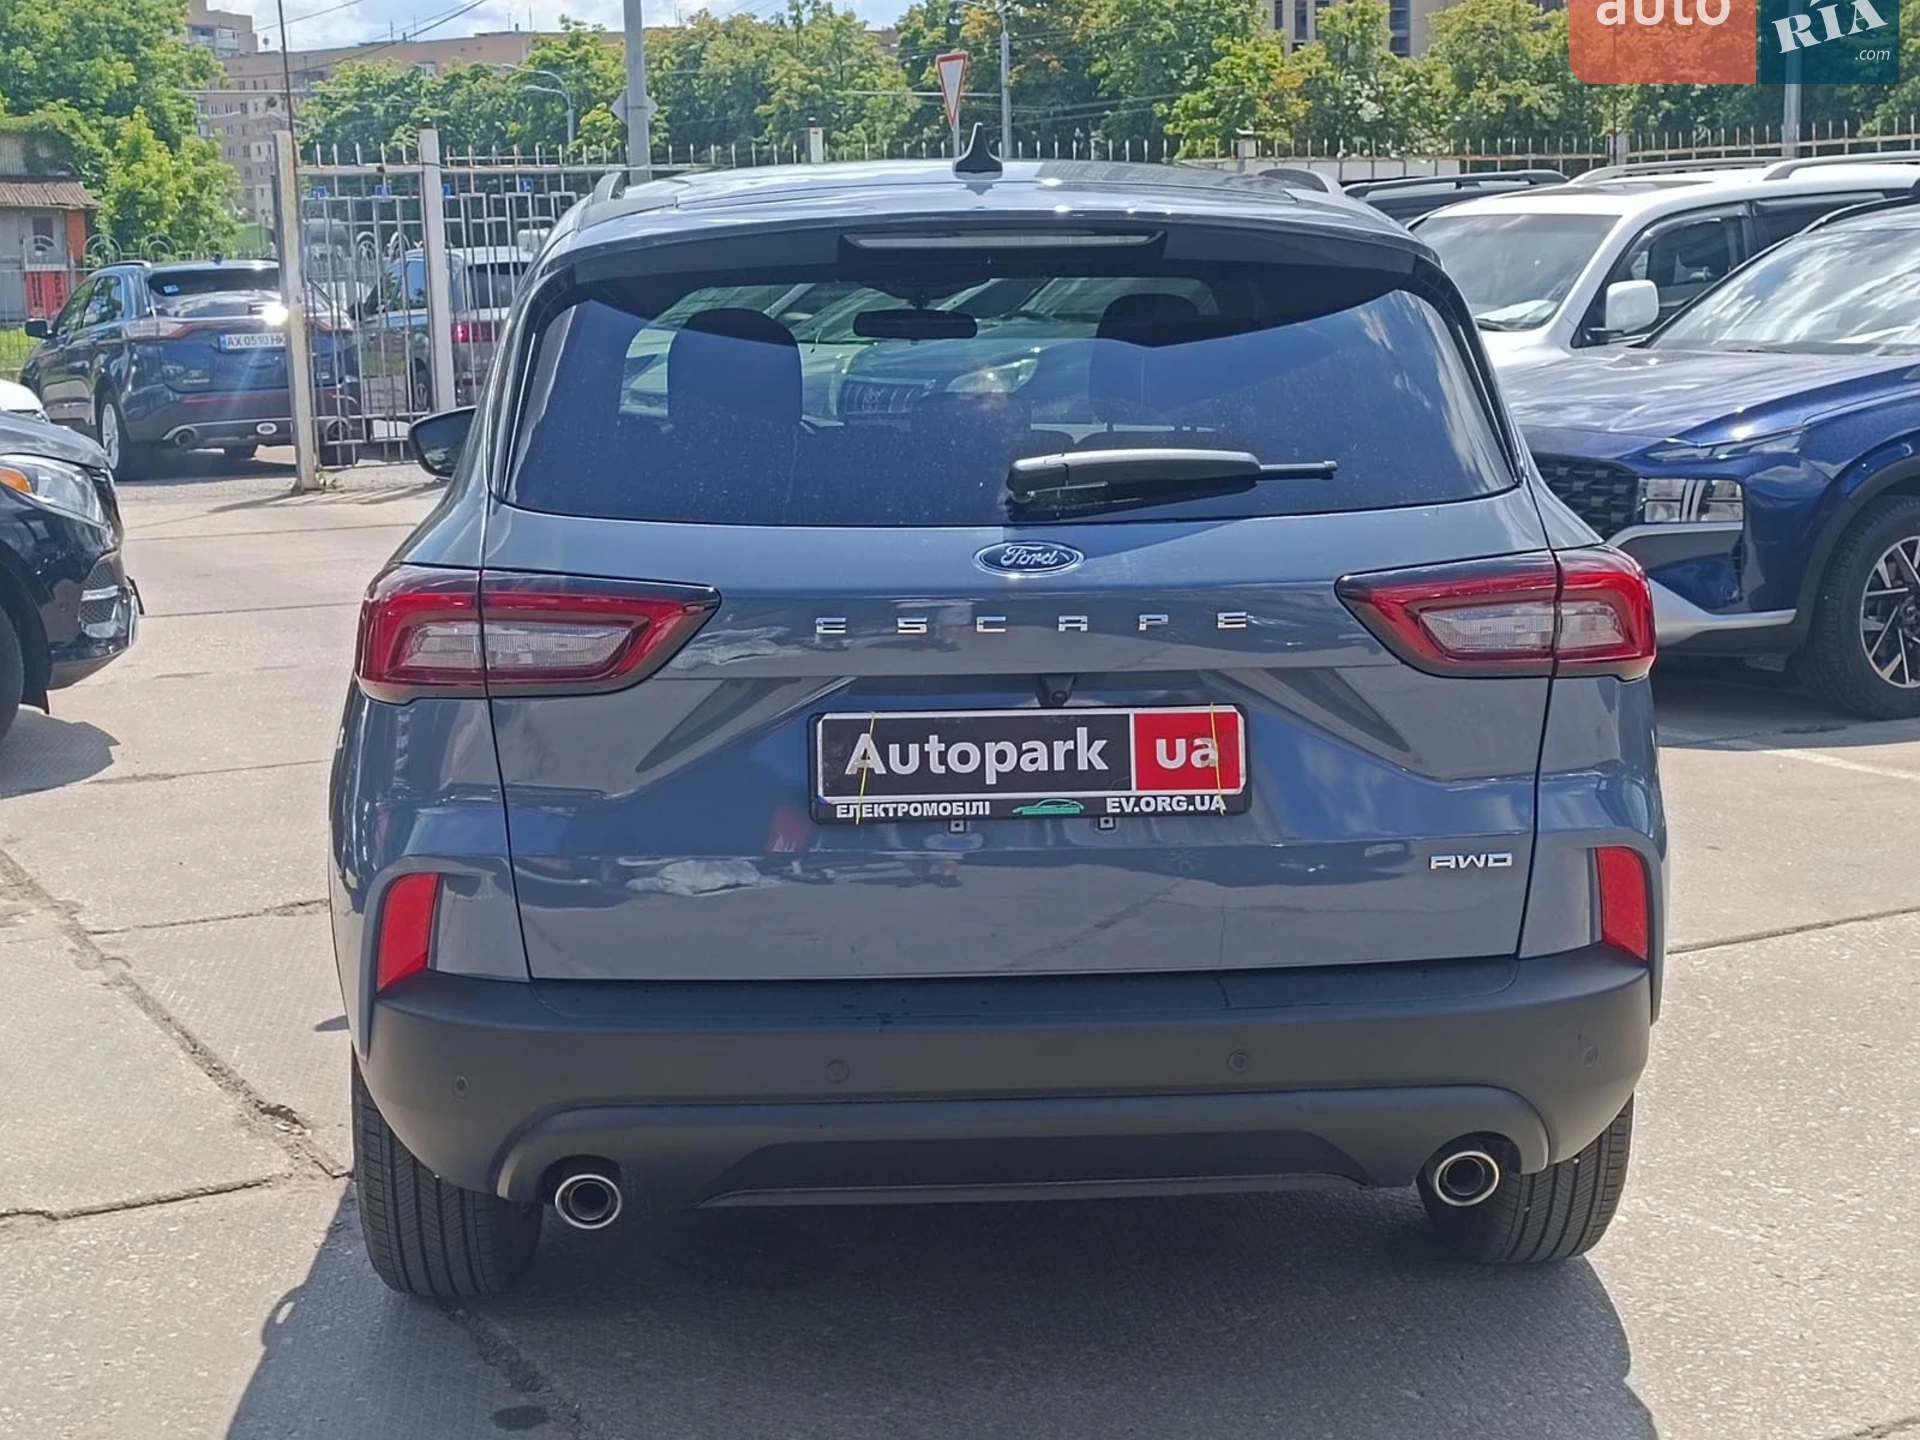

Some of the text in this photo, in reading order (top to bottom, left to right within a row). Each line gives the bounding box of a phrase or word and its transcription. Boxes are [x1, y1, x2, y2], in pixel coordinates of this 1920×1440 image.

[227, 335, 242, 347] AX
[244, 335, 269, 346] 0510
[1000, 545, 1059, 566] Ford
[814, 611, 1248, 634] ESCAPE
[844, 726, 1218, 786] Autopark ua
[836, 800, 991, 818] ЕЛЕКТРОМОБІЛІ
[1106, 794, 1227, 815] EV.ORG.UA
[1430, 852, 1513, 870] AWD
